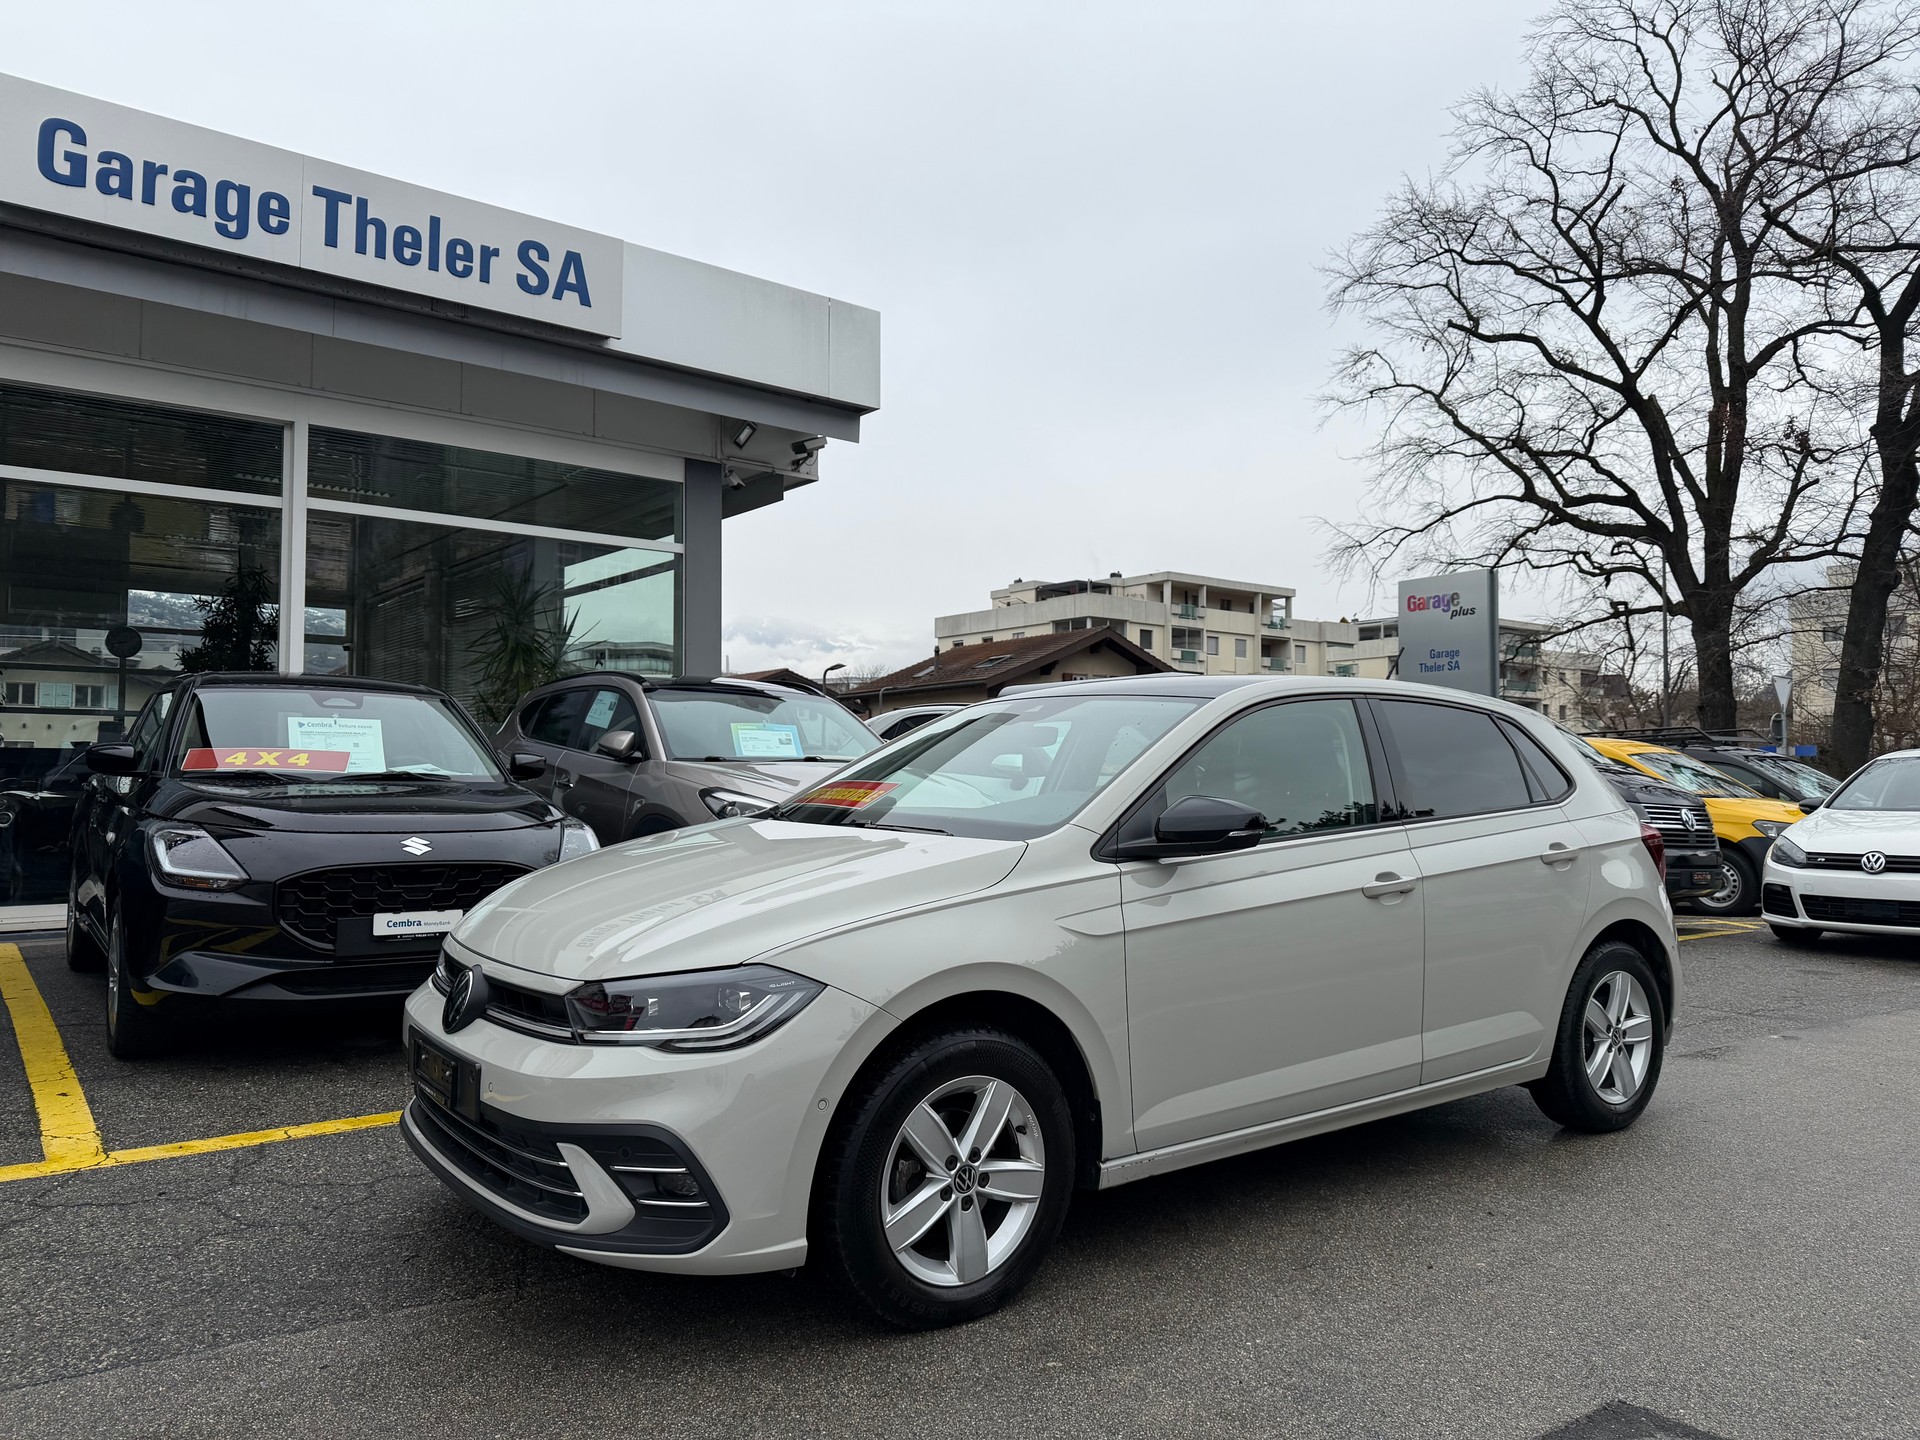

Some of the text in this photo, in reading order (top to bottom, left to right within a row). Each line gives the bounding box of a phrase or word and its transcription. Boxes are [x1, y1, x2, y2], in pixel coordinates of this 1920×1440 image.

[36, 117, 593, 308] Garage Theler SA
[1407, 591, 1460, 613] Garage
[1449, 606, 1476, 620] plus
[1429, 648, 1460, 660] Garage
[1419, 660, 1460, 673] Theler SA
[225, 751, 311, 767] 4X4
[386, 919, 422, 928] Cembra
